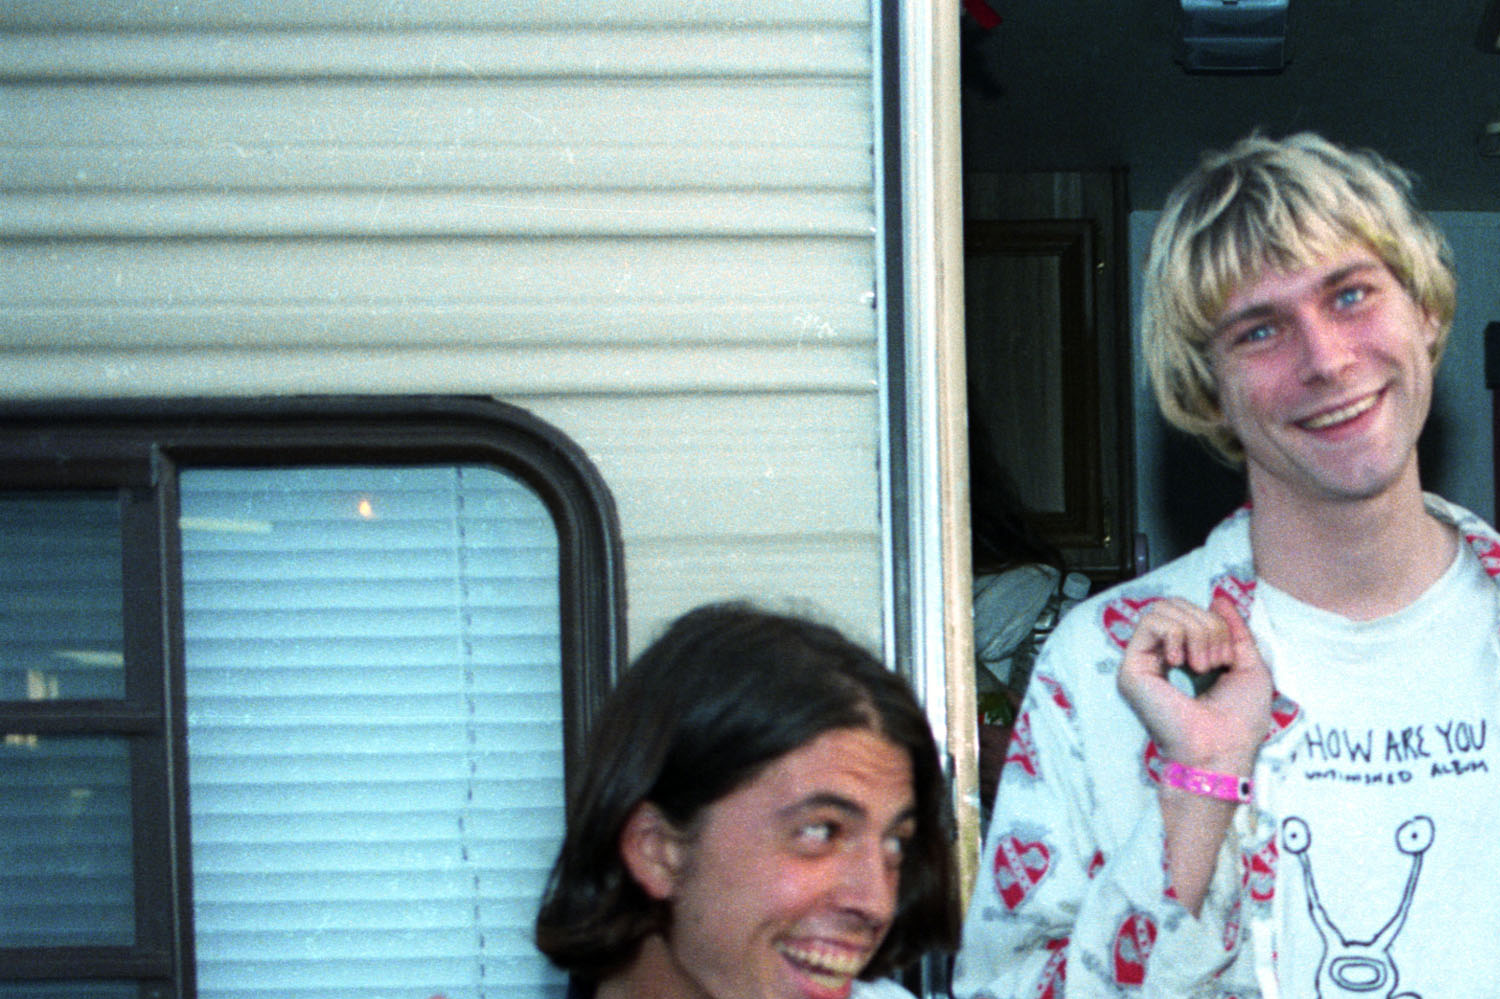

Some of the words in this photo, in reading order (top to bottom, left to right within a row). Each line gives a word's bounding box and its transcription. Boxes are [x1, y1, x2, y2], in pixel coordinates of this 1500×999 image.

[1305, 723, 1373, 763] HOW
[1385, 724, 1431, 763] ARE
[1434, 718, 1487, 754] YOU
[1430, 759, 1489, 779] ALBUM
